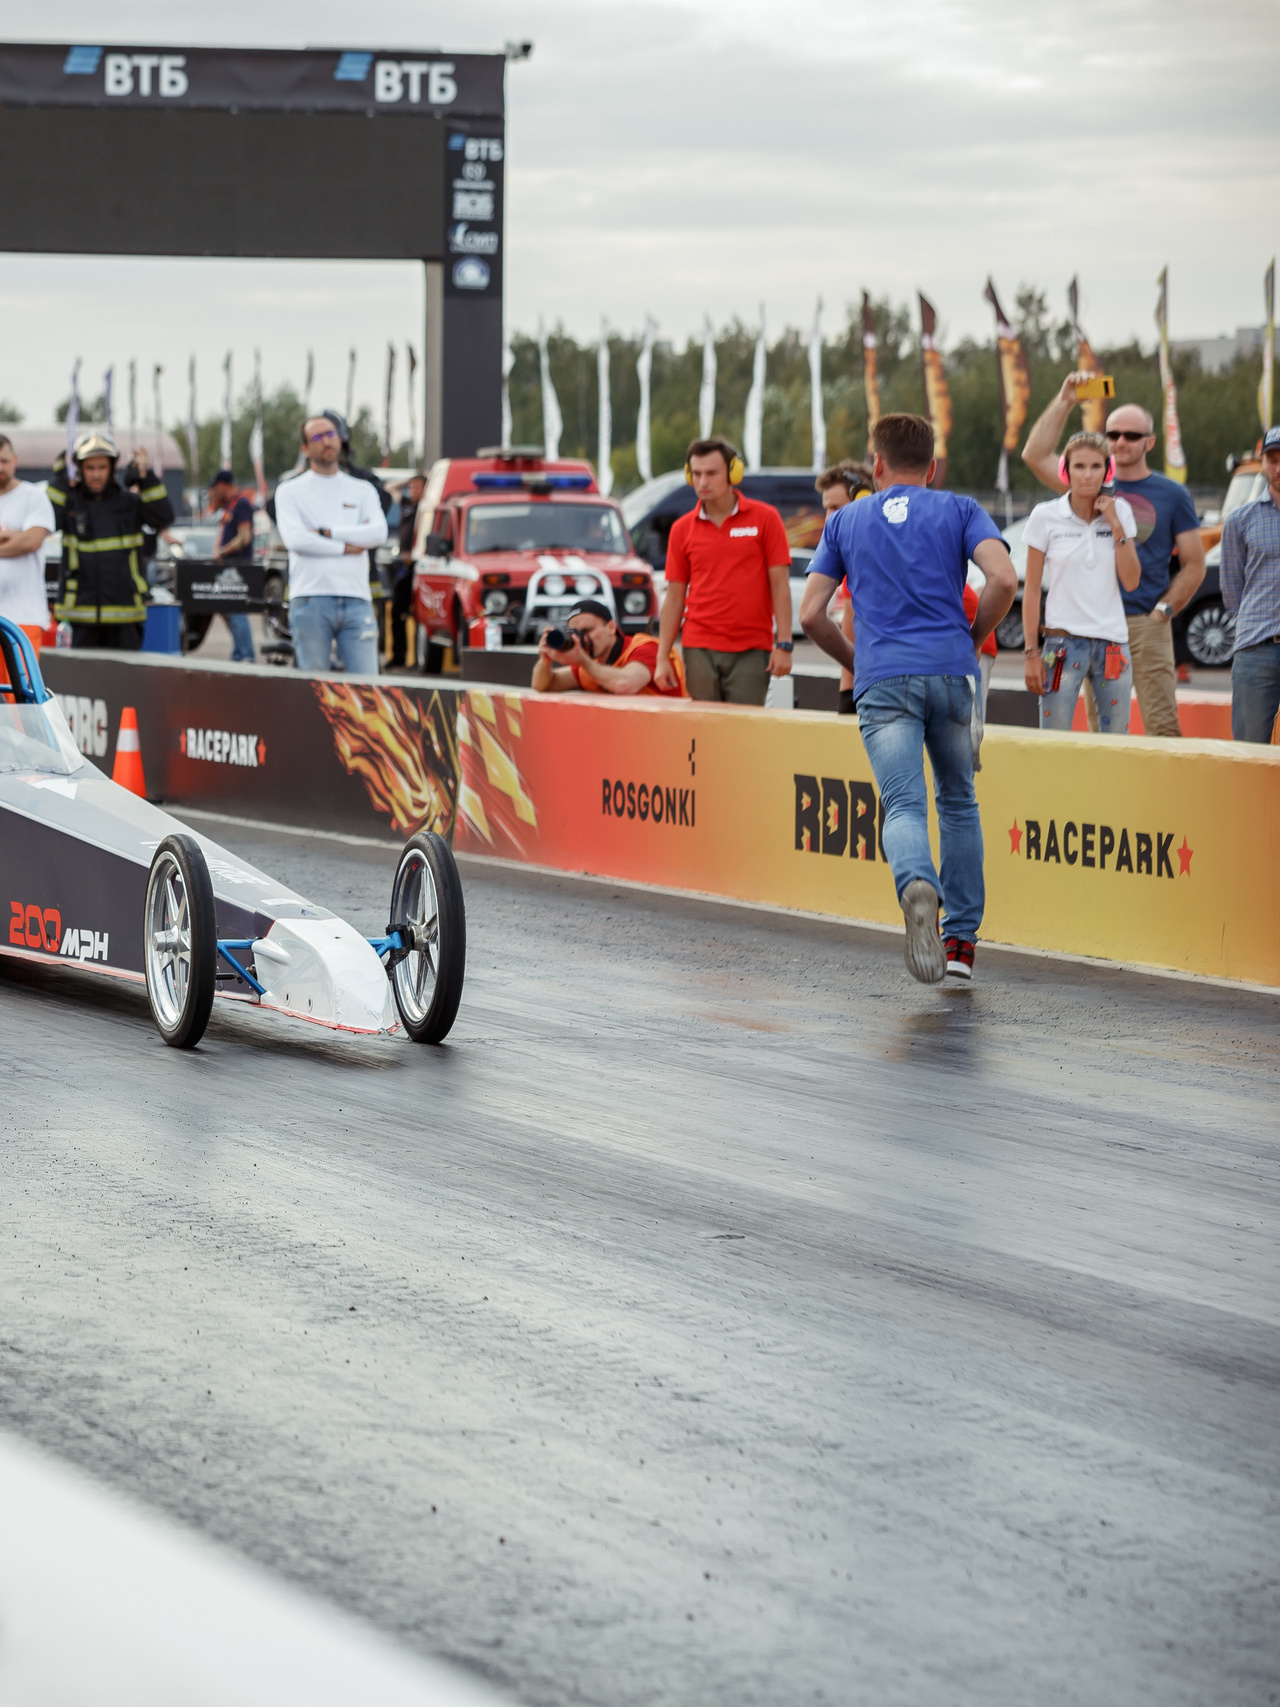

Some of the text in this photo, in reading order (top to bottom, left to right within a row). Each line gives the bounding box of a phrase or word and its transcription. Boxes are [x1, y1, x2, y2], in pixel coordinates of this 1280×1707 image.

[103, 54, 189, 98] ВТБ
[374, 61, 458, 104] ВТБ
[464, 138, 503, 162] ВТБ
[54, 692, 108, 758] DRC
[186, 727, 259, 768] RACEPARK
[602, 778, 696, 827] ROSGONKI
[793, 773, 888, 864] RDR
[1025, 819, 1175, 880] RACEPARK
[9, 900, 110, 963] 200 MPH
